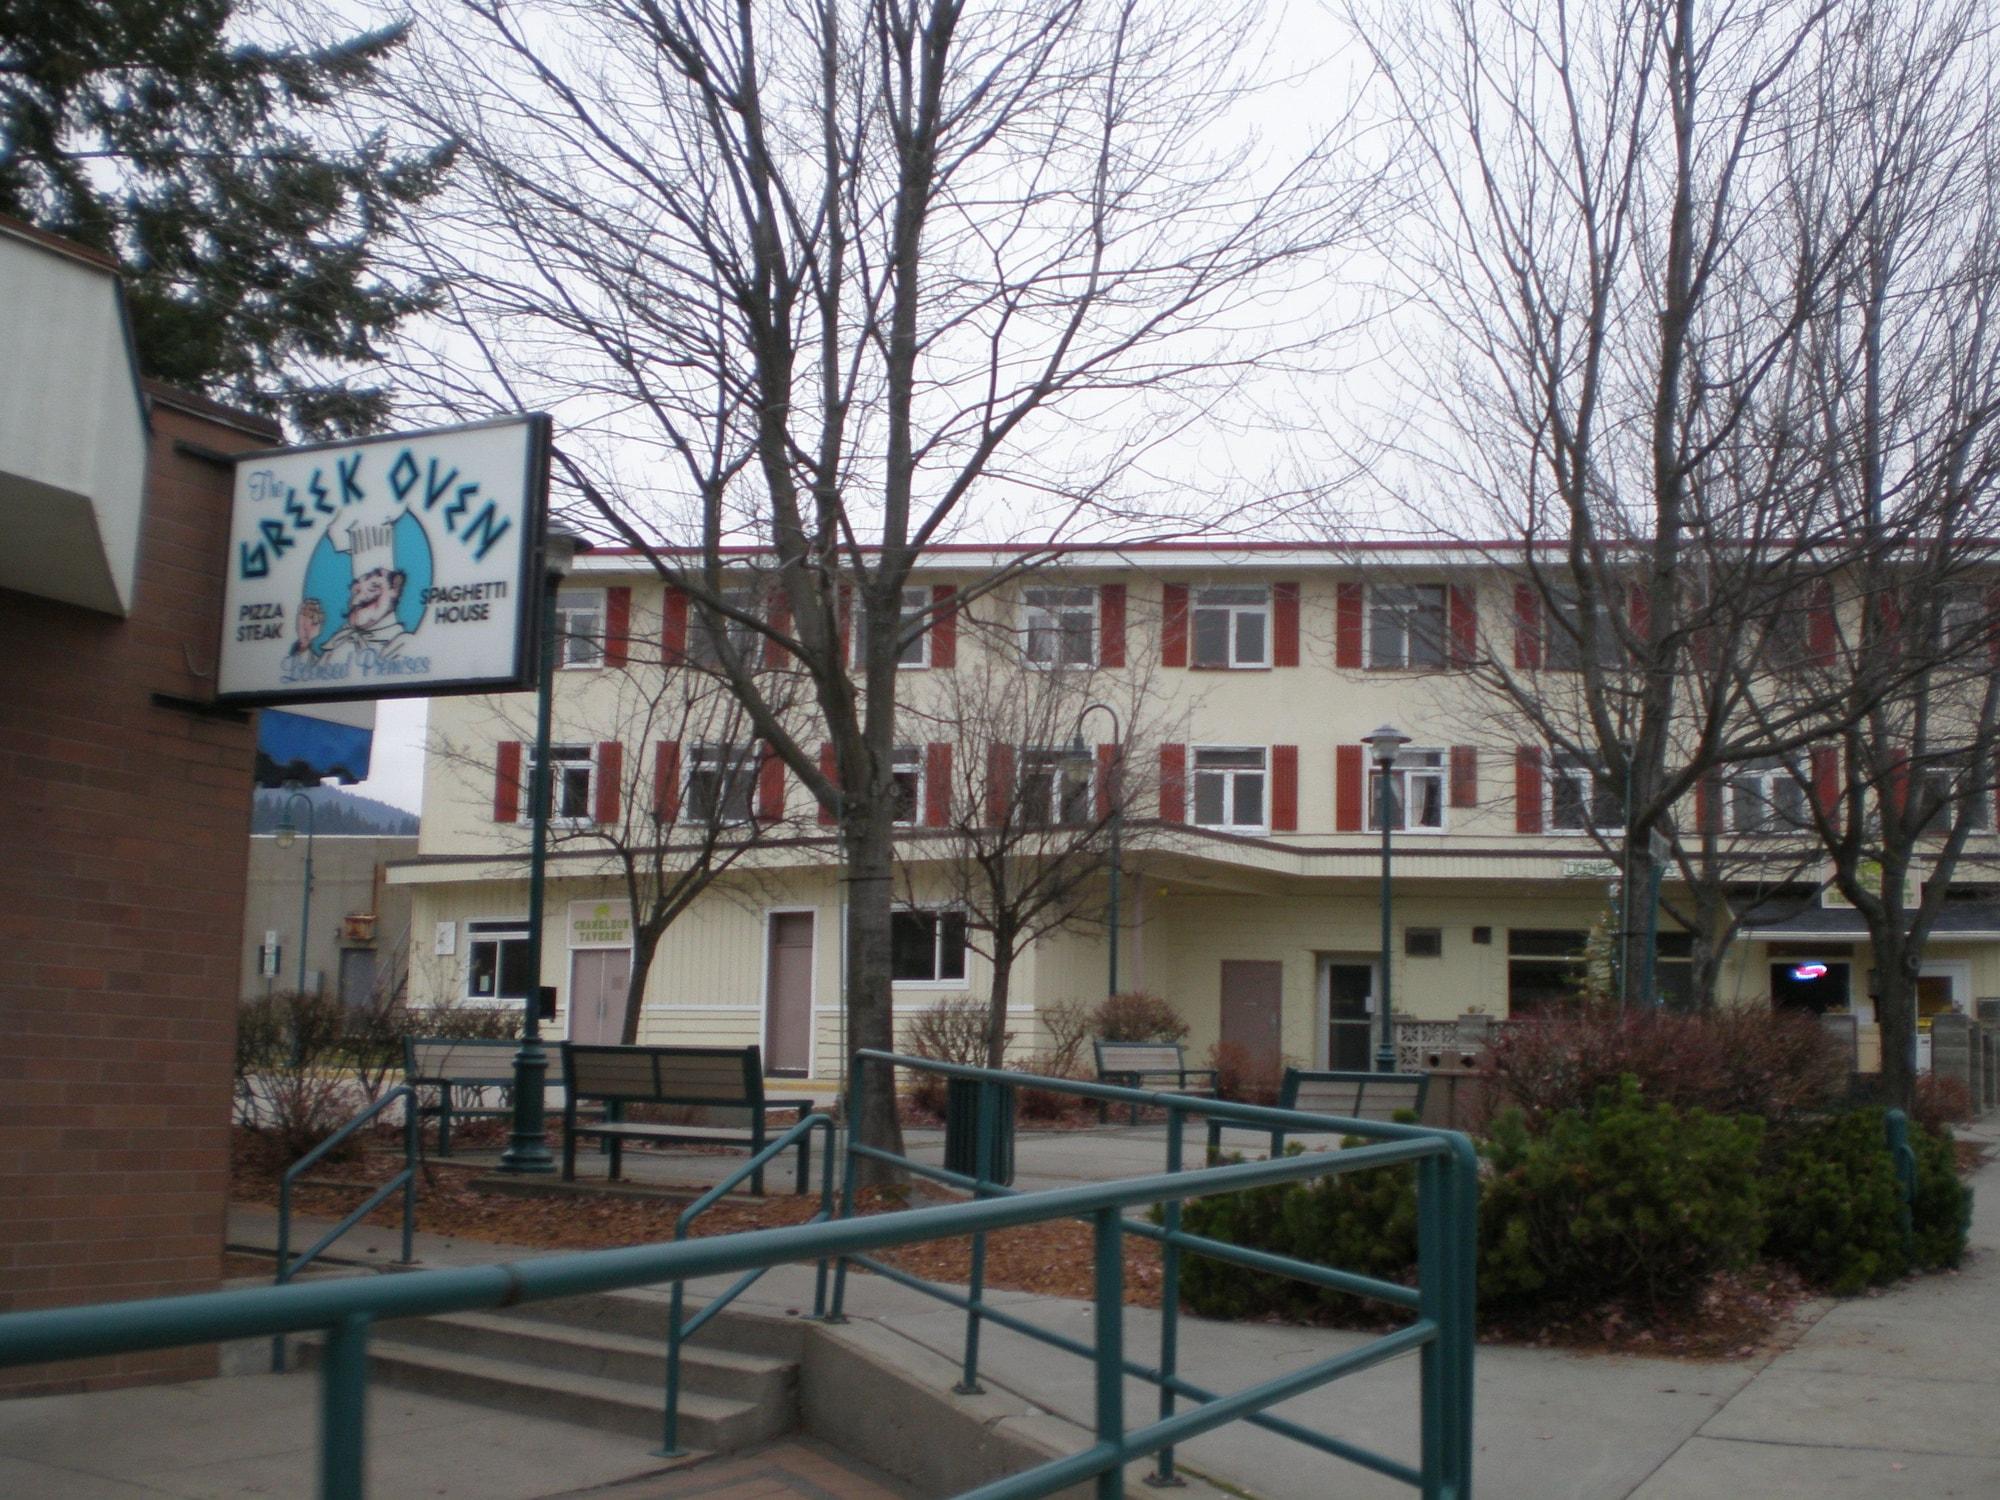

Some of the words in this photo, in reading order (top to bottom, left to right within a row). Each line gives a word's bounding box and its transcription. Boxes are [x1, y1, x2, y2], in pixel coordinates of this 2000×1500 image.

[249, 470, 285, 502] The
[240, 453, 365, 579] GREEK
[388, 448, 512, 562] OVEN
[419, 581, 507, 605] SPAGHETTI
[239, 603, 285, 621] PIZZA
[434, 603, 490, 625] HOUSE
[236, 623, 284, 642] STEAK
